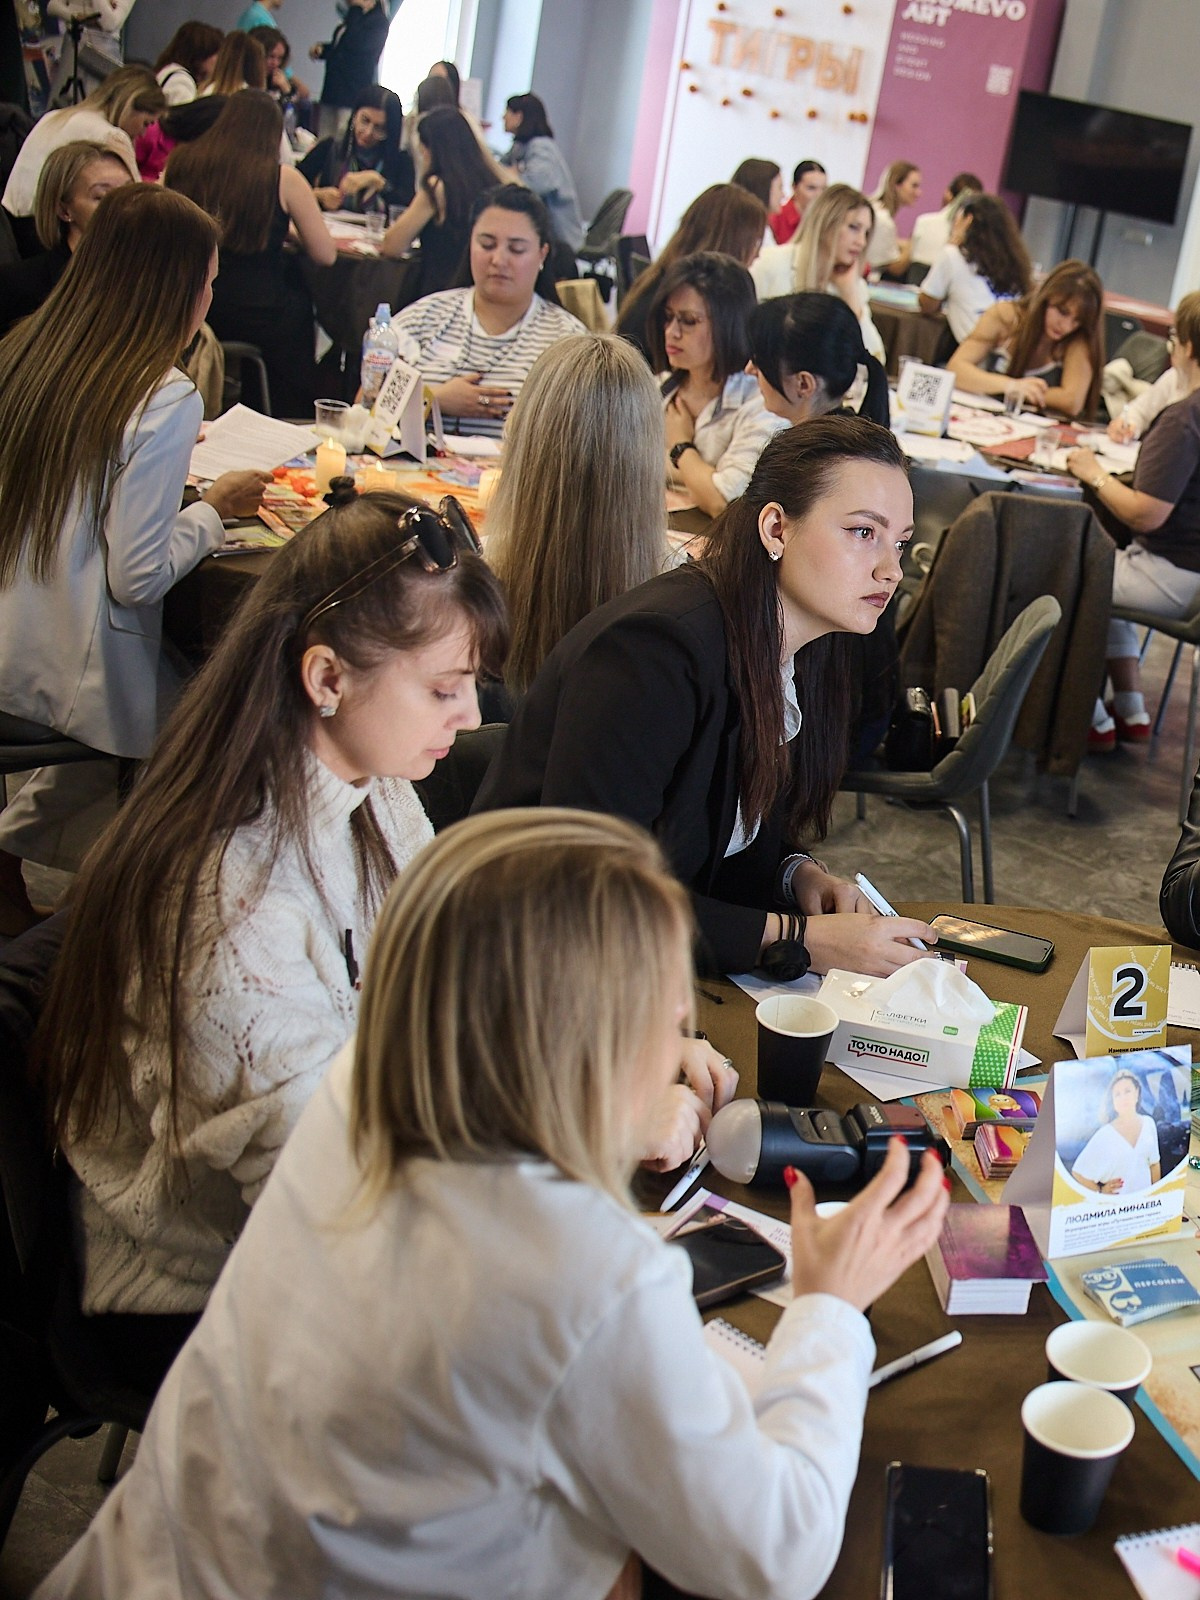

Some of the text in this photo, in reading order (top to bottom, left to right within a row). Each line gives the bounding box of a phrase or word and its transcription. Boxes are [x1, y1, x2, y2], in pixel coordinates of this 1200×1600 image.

[708, 19, 864, 95] ТИГРЫ
[1113, 967, 1144, 1017] 2
[889, 1047, 926, 1063] НАДО!
[1065, 1199, 1162, 1225] ЛЮДМИЛА МИНАЕВА
[1133, 1277, 1186, 1289] ПЕРСОНАЖ
